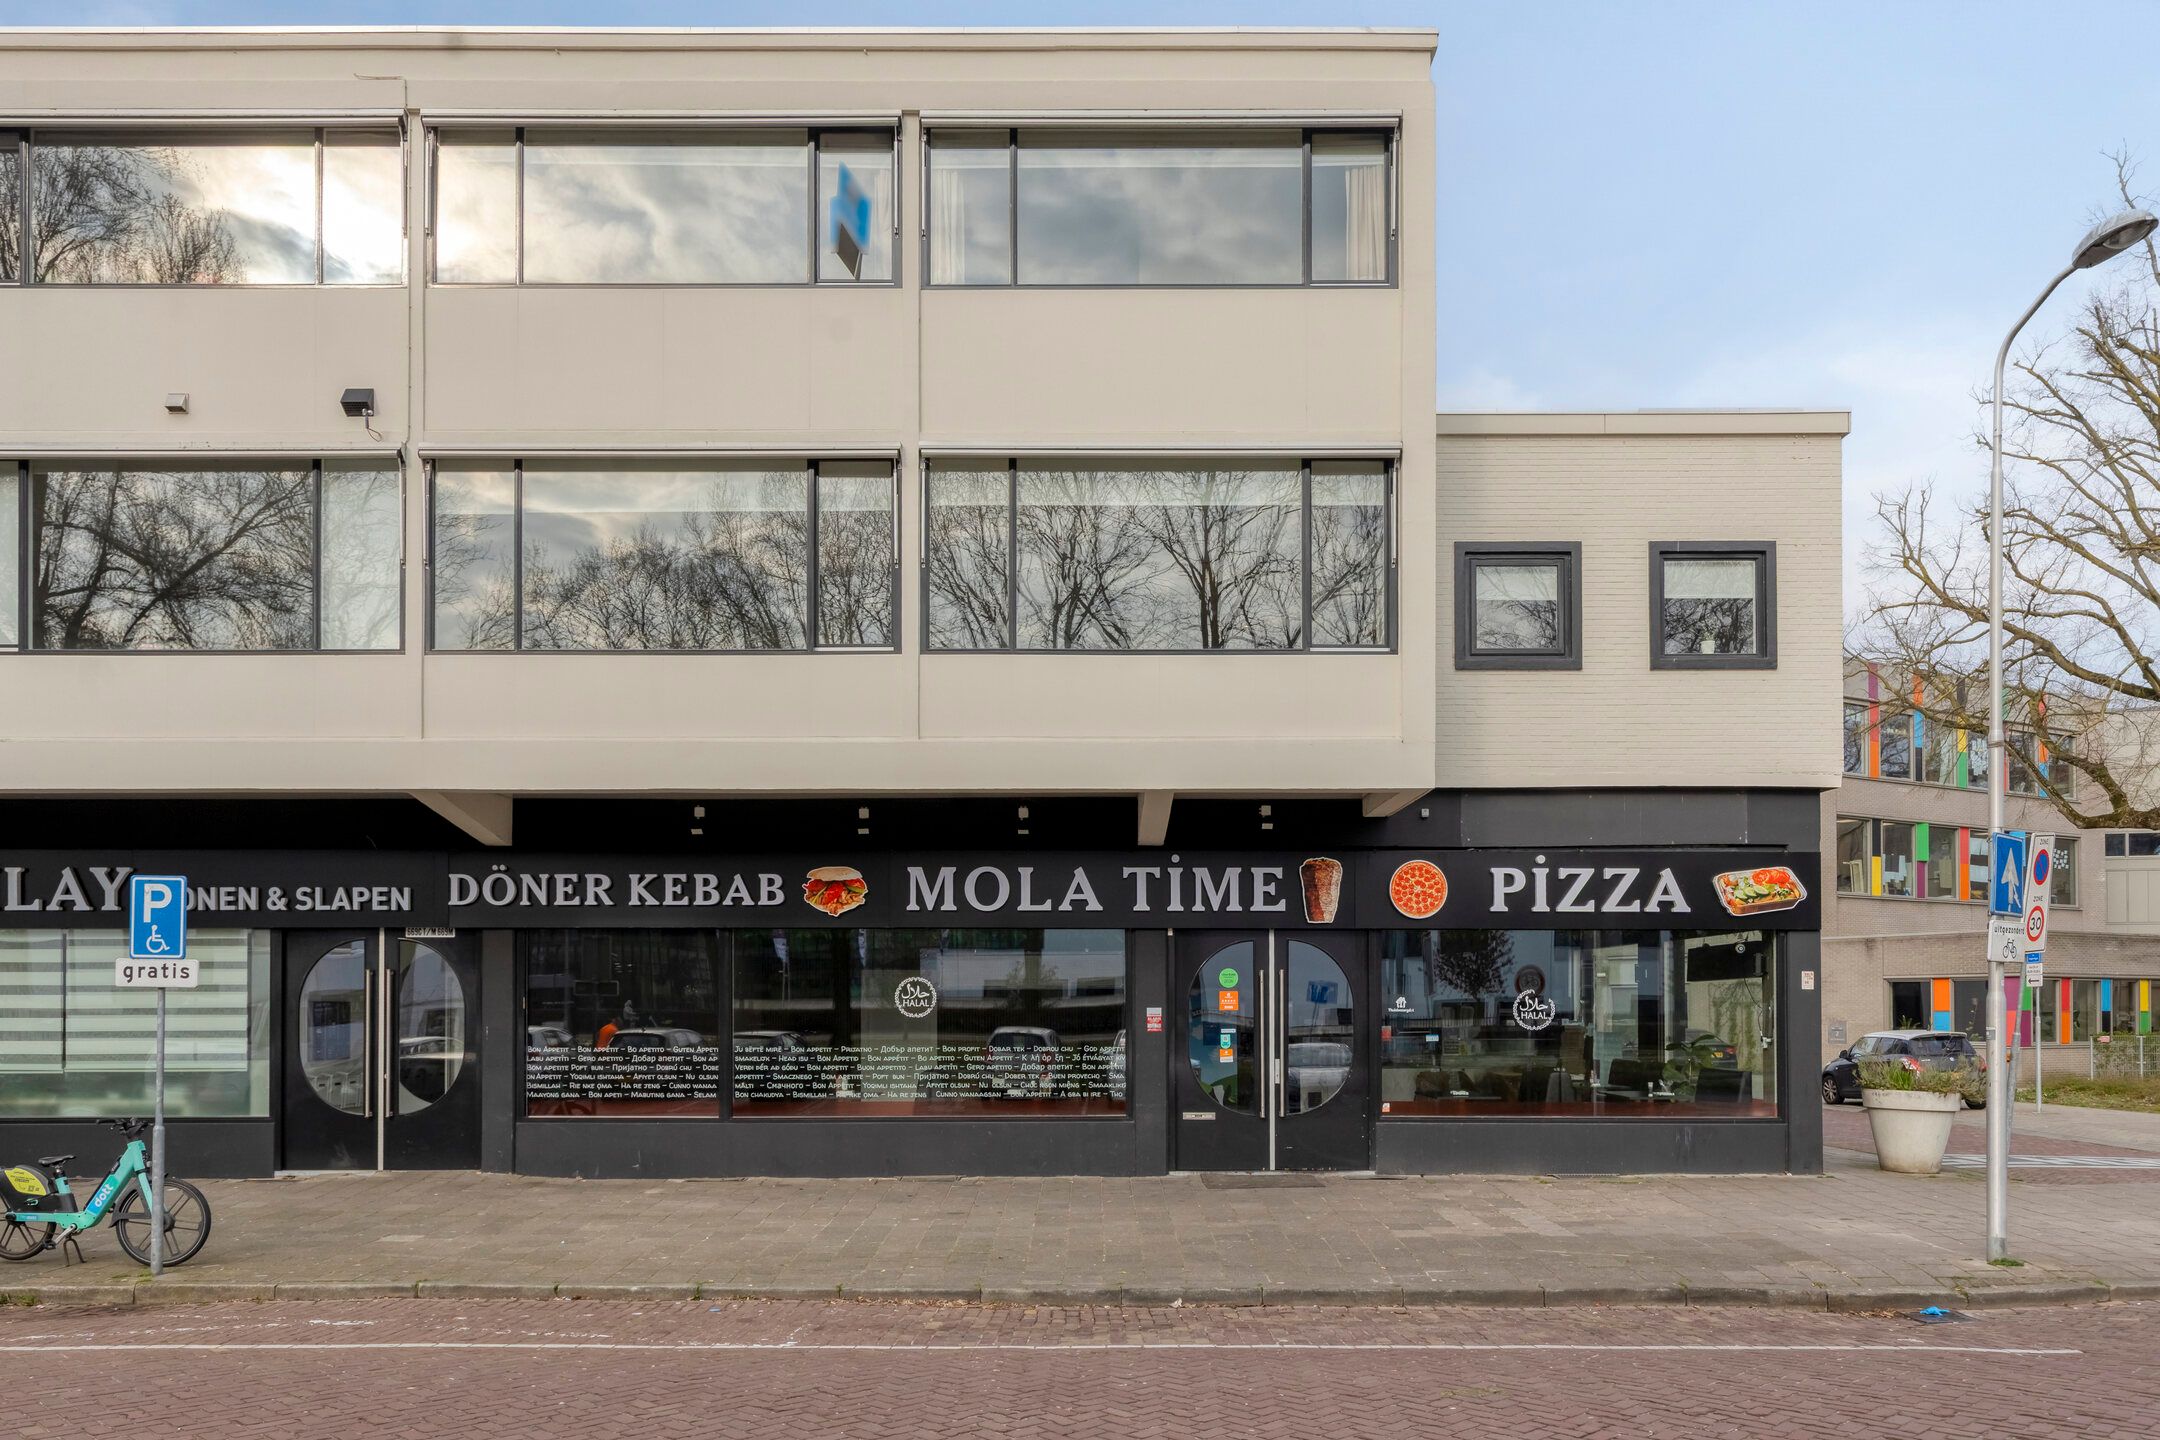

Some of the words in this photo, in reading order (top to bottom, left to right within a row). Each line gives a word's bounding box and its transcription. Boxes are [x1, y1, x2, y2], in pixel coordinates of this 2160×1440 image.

[448, 864, 614, 907] DÖNER
[628, 873, 786, 907] KEBAB
[905, 866, 1104, 912] MOLA
[143, 883, 172, 923] P
[266, 886, 288, 911] &
[295, 886, 412, 911] SLAPEN
[2030, 917, 2041, 930] 30
[123, 963, 190, 983] gratis
[901, 983, 930, 999] حلال
[1520, 996, 1548, 1011] حلال
[1521, 1012, 1547, 1020] HALAL
[95, 1184, 114, 1207] dott
